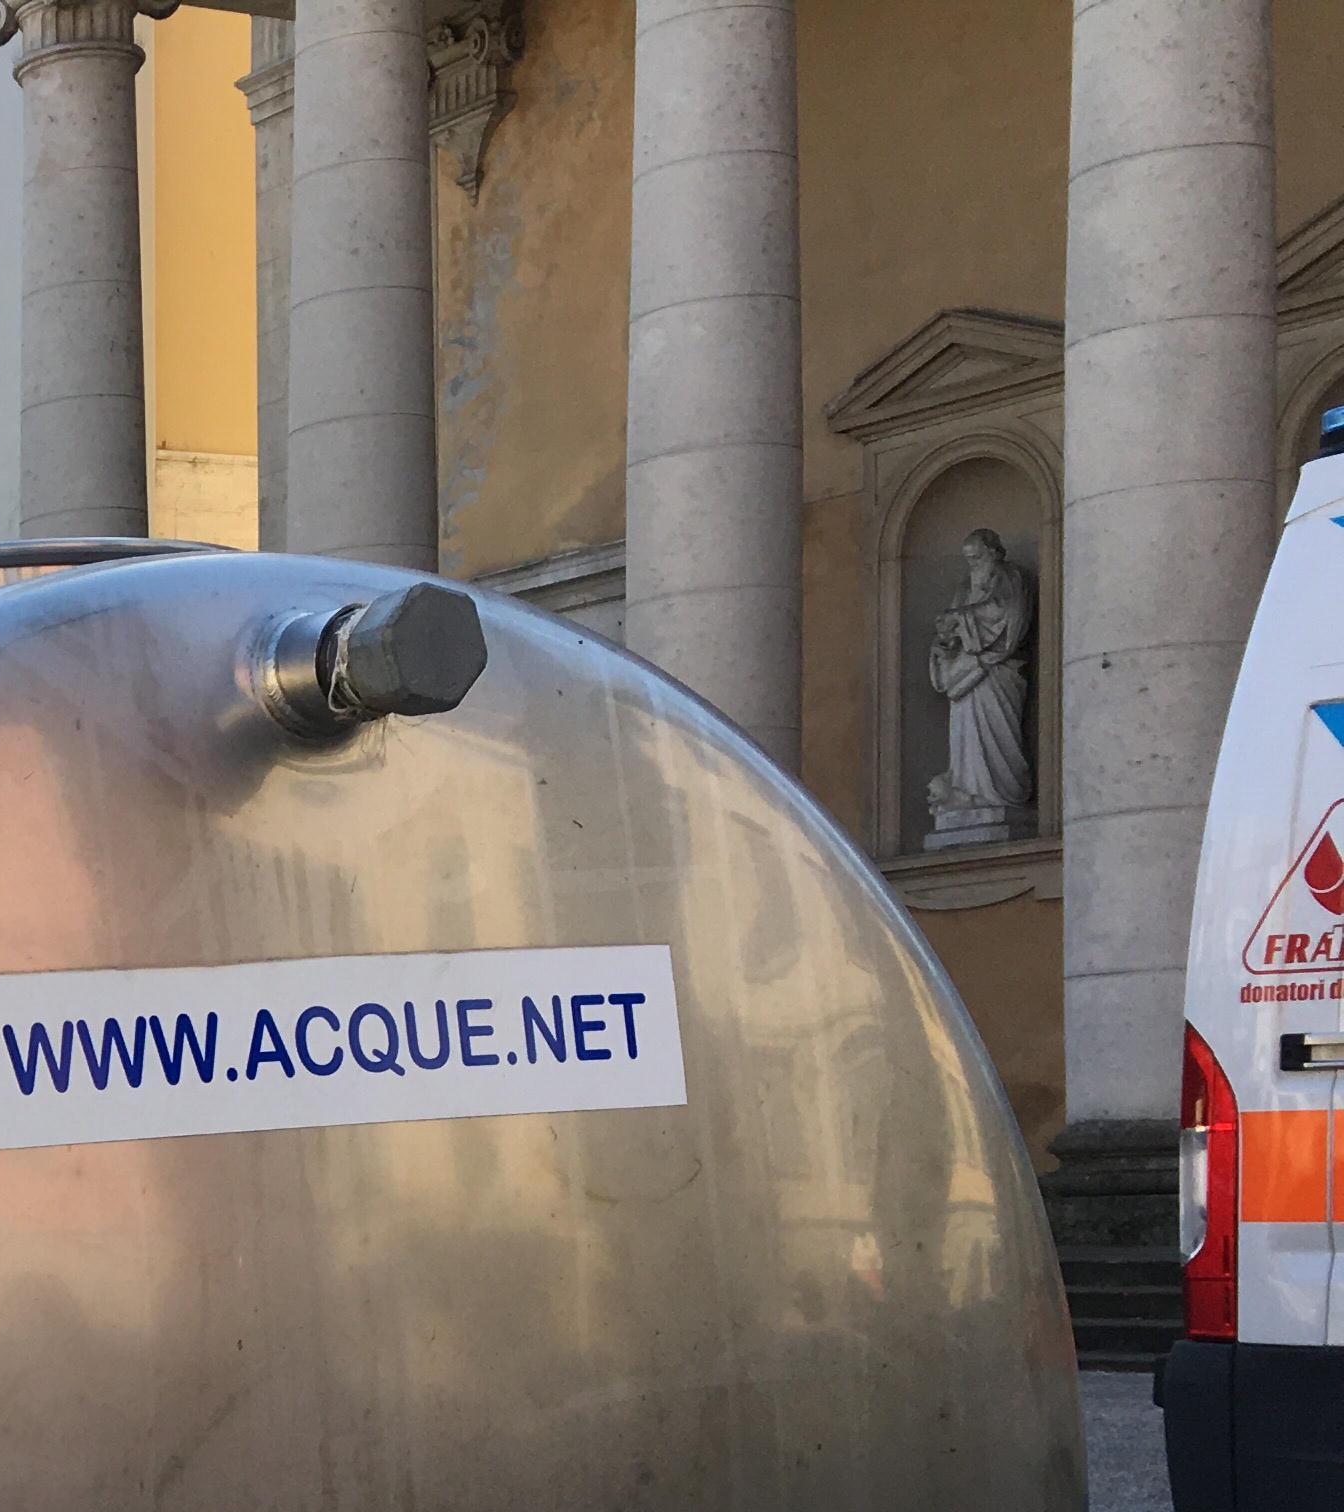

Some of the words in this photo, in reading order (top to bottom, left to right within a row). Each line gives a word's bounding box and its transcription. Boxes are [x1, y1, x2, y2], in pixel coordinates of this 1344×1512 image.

[1240, 979, 1326, 1003] donatori
[1329, 978, 1344, 1000] d
[2, 993, 646, 1096] WWW.ACQUE.NET
